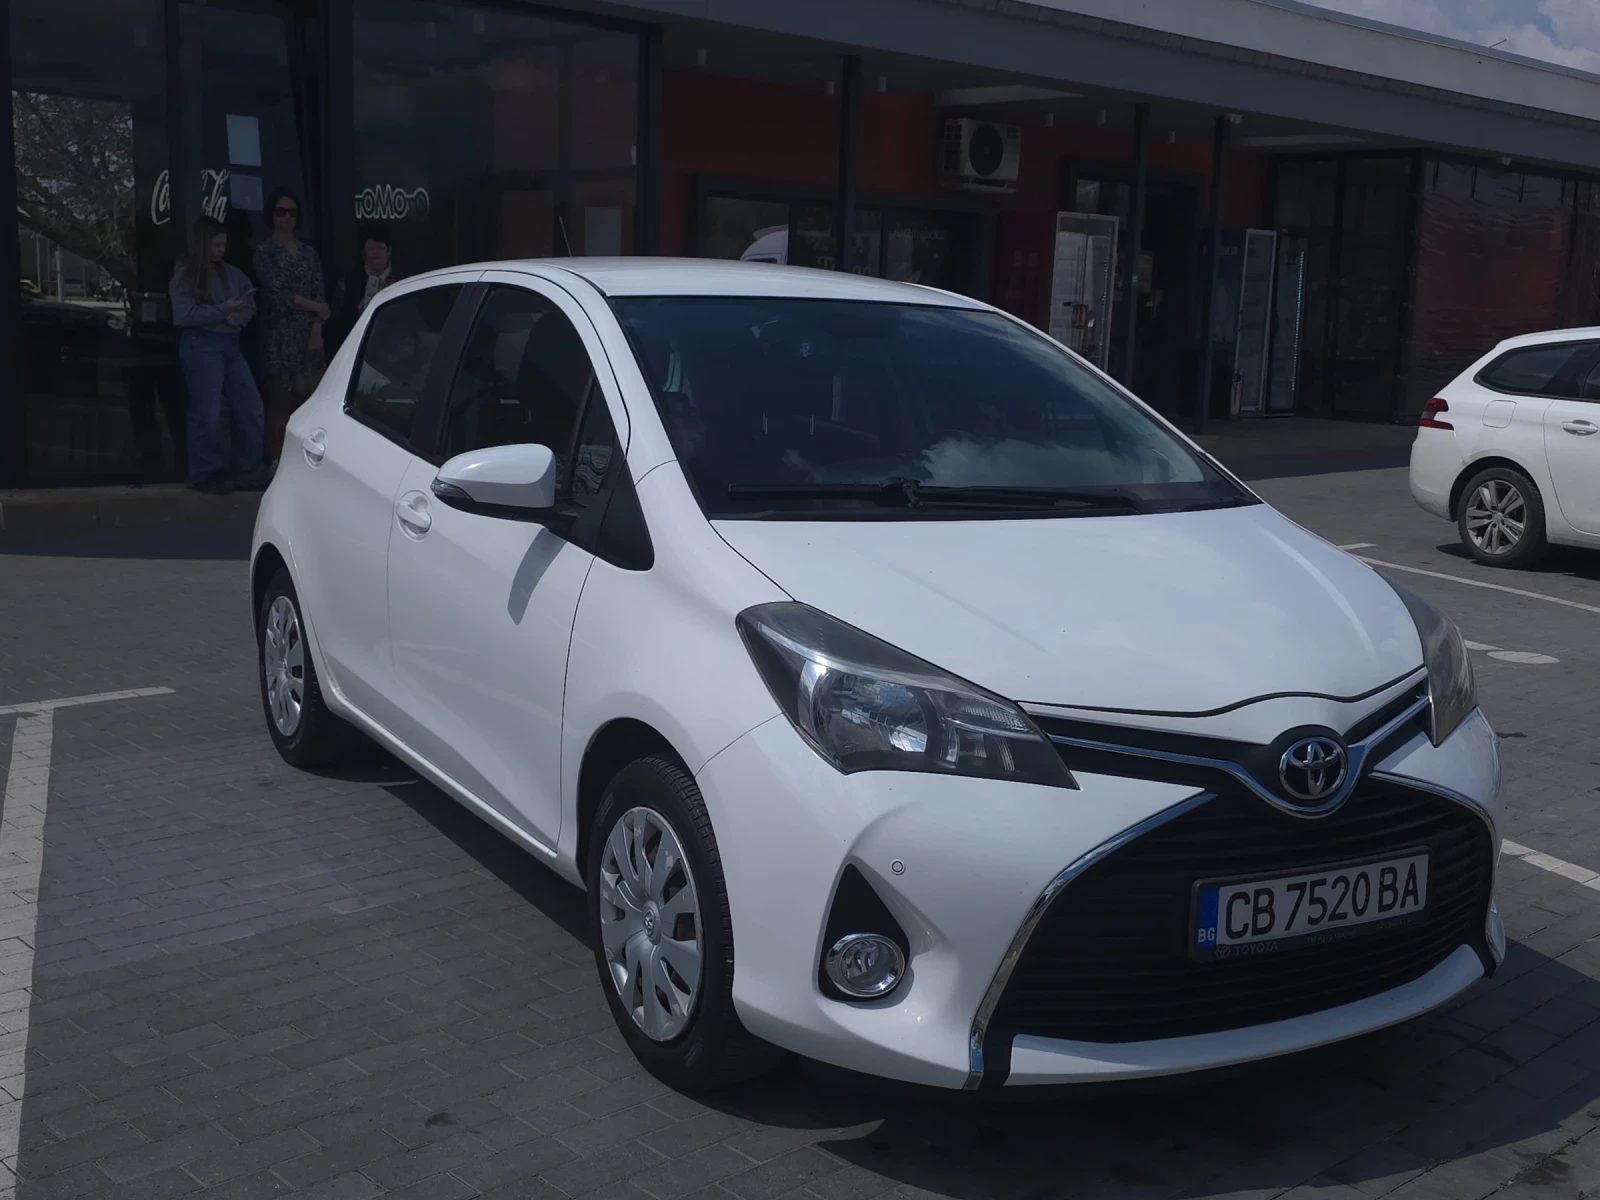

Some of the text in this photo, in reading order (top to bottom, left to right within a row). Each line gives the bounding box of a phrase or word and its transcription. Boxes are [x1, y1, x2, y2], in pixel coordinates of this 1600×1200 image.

[1225, 862, 1419, 939] CB 7520 BA
[1197, 927, 1216, 943] BG
[1235, 940, 1279, 956] TOYOTA
